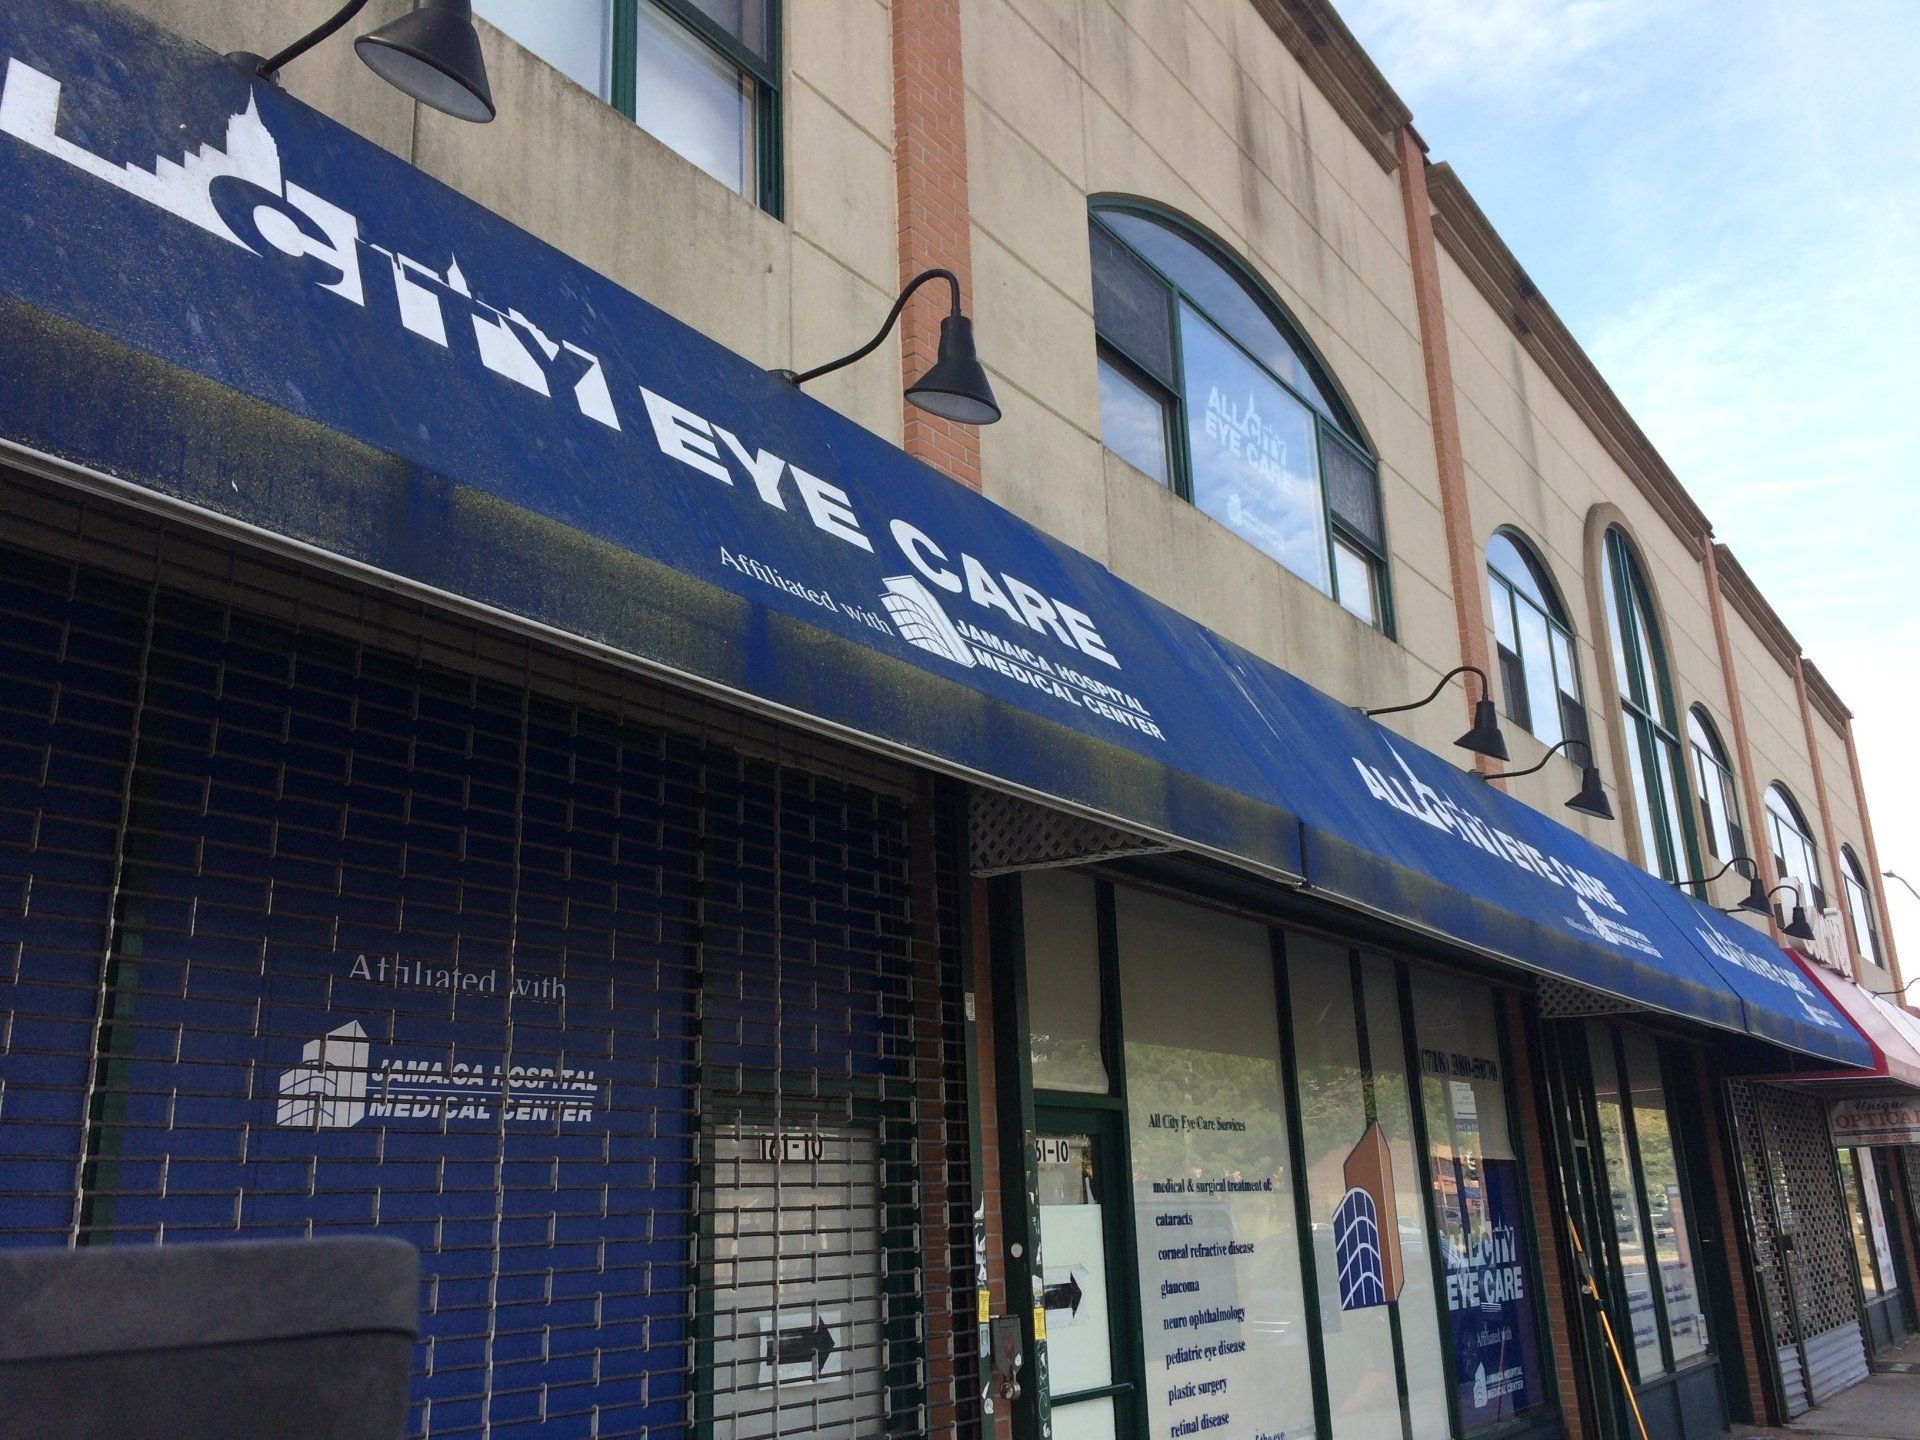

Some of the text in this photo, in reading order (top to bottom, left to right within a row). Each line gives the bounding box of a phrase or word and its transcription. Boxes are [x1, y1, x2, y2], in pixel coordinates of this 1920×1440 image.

[205, 85, 622, 432] CITY
[639, 385, 874, 553] EYE
[890, 518, 1121, 670] CARE
[1207, 386, 1248, 436] ALL
[1206, 409, 1241, 457] EYE
[1247, 443, 1293, 496] CARE
[721, 546, 895, 636] Affiliated with
[957, 619, 1150, 716] JAMAICA HOSPITAL
[972, 647, 1166, 741] MEDICAL CENTER
[1351, 757, 1428, 820] ALL
[1492, 828, 1565, 887] EYE
[1549, 856, 1628, 915] CARE
[512, 973, 566, 1004] with
[1149, 1113, 1246, 1132] All City Eye Care Services
[1153, 1179, 1185, 1193] medical
[1187, 1179, 1194, 1192] &
[1196, 1179, 1226, 1196] surgical
[1228, 1179, 1262, 1192] treatment
[1156, 1213, 1193, 1226] cataracts
[1158, 1241, 1254, 1260] corneal refractive disease
[1481, 1218, 1516, 1267] CITY
[1161, 1280, 1200, 1299] glaucoma
[1446, 1266, 1523, 1311] EYE CARE
[1164, 1306, 1245, 1330] neuro ophthalmology
[1166, 1340, 1246, 1370] pediatric eye disease
[1168, 1378, 1228, 1406] plastic surgery
[1171, 1412, 1230, 1438] retinal disease
